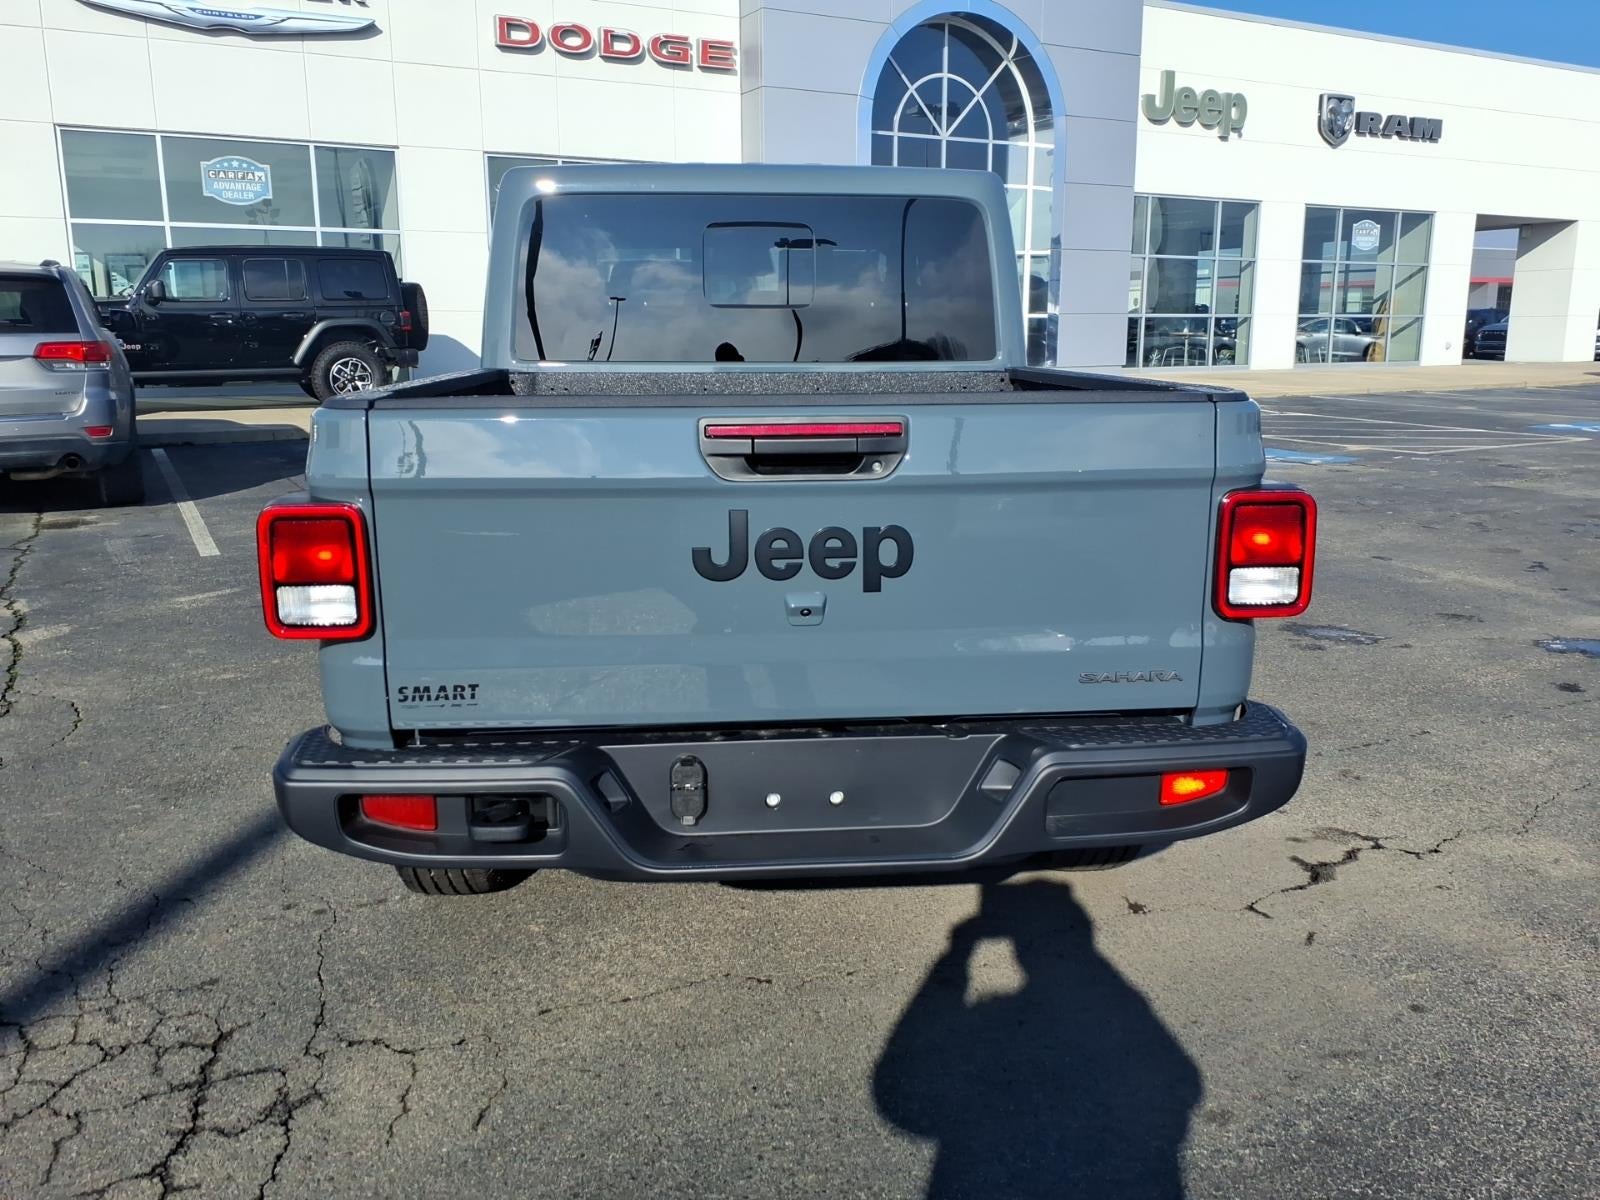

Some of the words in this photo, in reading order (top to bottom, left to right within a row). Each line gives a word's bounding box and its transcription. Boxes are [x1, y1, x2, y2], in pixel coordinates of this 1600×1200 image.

[194, 9, 256, 20] CHRYSLER
[494, 14, 738, 70] DODGE
[1141, 69, 1248, 141] Jeep
[1355, 111, 1443, 142] RAM
[207, 169, 266, 182] CARFAX
[213, 181, 263, 192] ADVANTAGE
[222, 190, 255, 200] DEALER
[691, 509, 914, 592] Jeep
[1079, 669, 1184, 684] SAHARA
[397, 683, 480, 702] SMART
